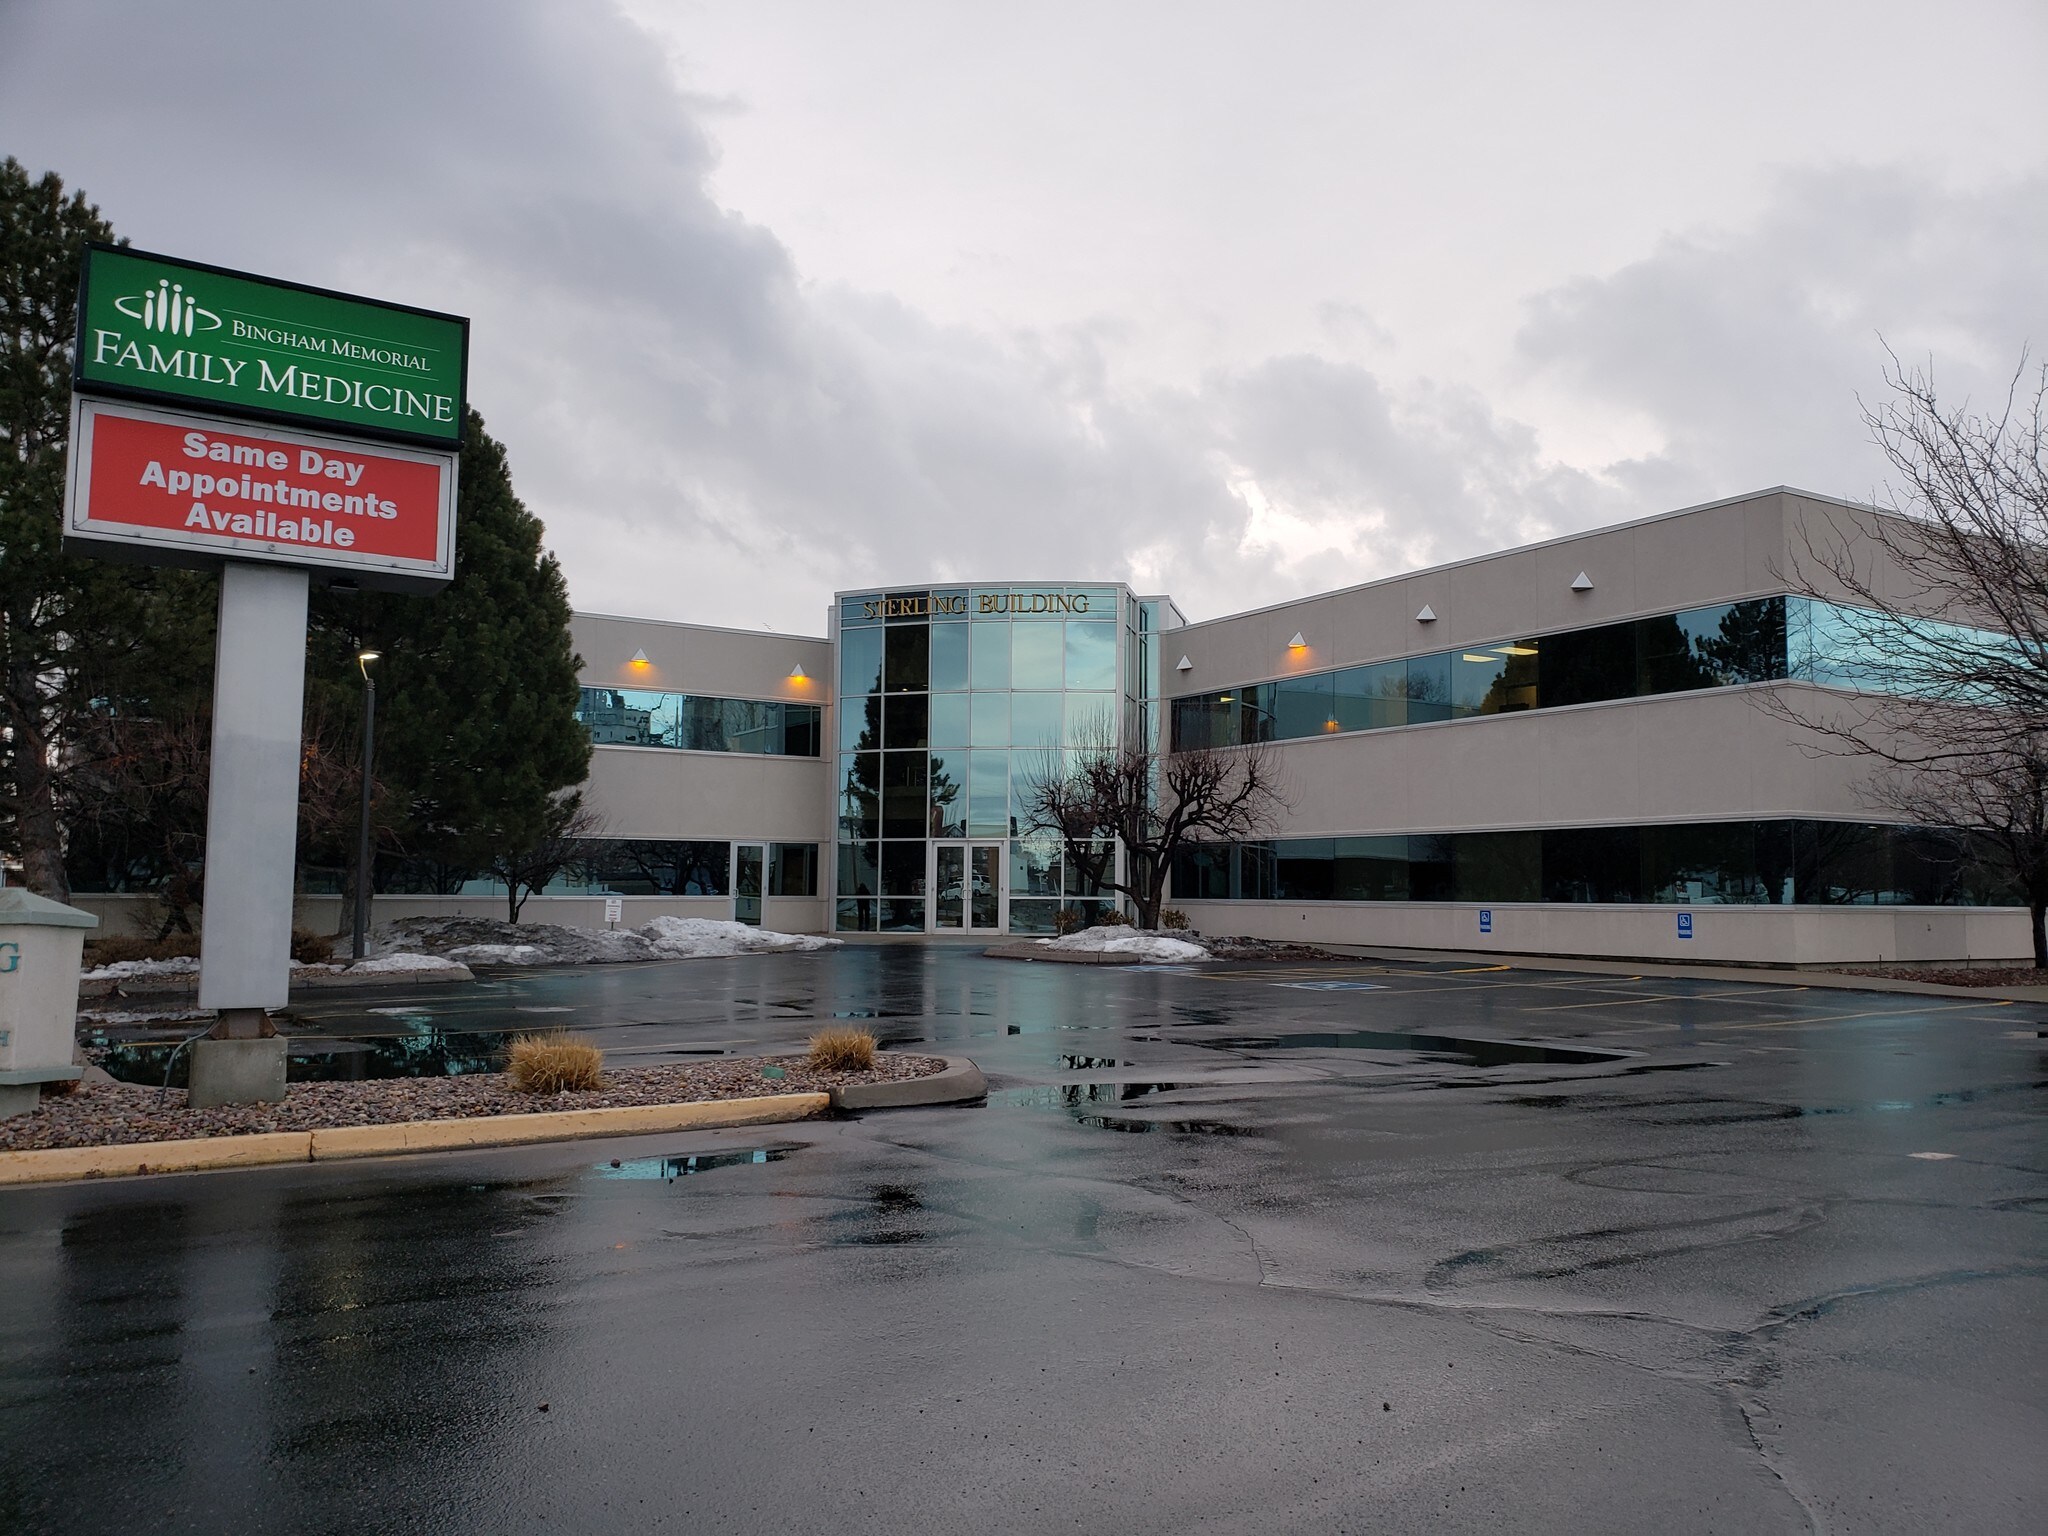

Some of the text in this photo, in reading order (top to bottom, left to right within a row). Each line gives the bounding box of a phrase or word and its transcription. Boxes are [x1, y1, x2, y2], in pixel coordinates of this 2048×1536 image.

[93, 328, 454, 423] FAMILY MEDICINE
[182, 432, 365, 486] Same Day
[139, 461, 398, 520] Appointments
[184, 502, 355, 547] Available
[863, 593, 1090, 619] STERLING BUILDING
